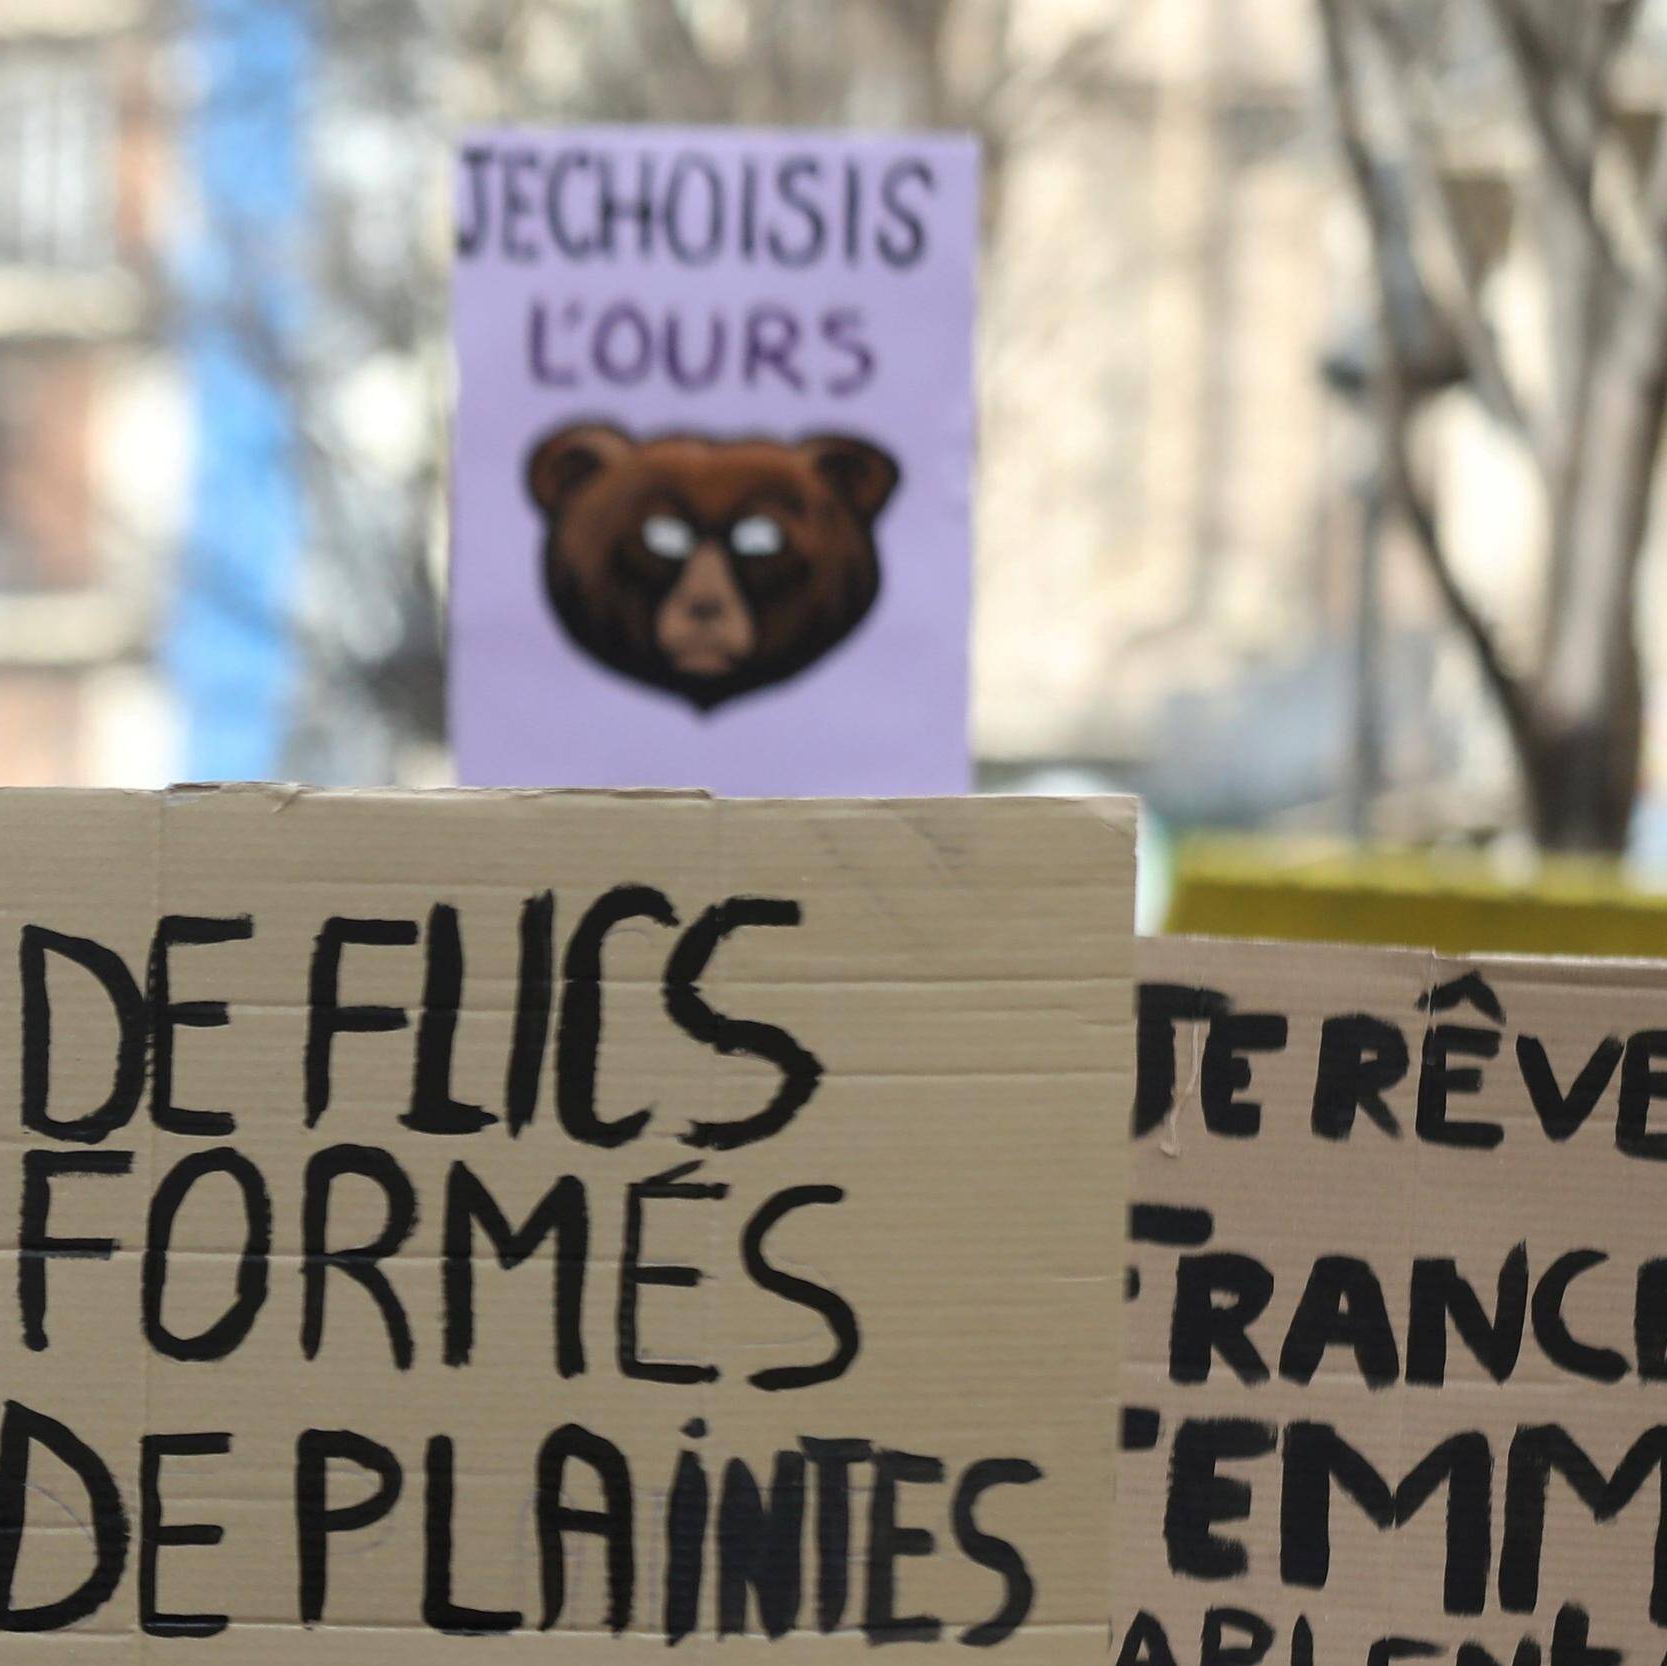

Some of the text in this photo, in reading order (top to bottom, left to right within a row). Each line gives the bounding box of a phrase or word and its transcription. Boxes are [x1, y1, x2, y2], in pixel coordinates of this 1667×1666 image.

[525, 299, 877, 399] L'OURS
[21, 910, 254, 1143] DE
[304, 883, 826, 1149] FLICS
[20, 1143, 861, 1392] FORMÉS
